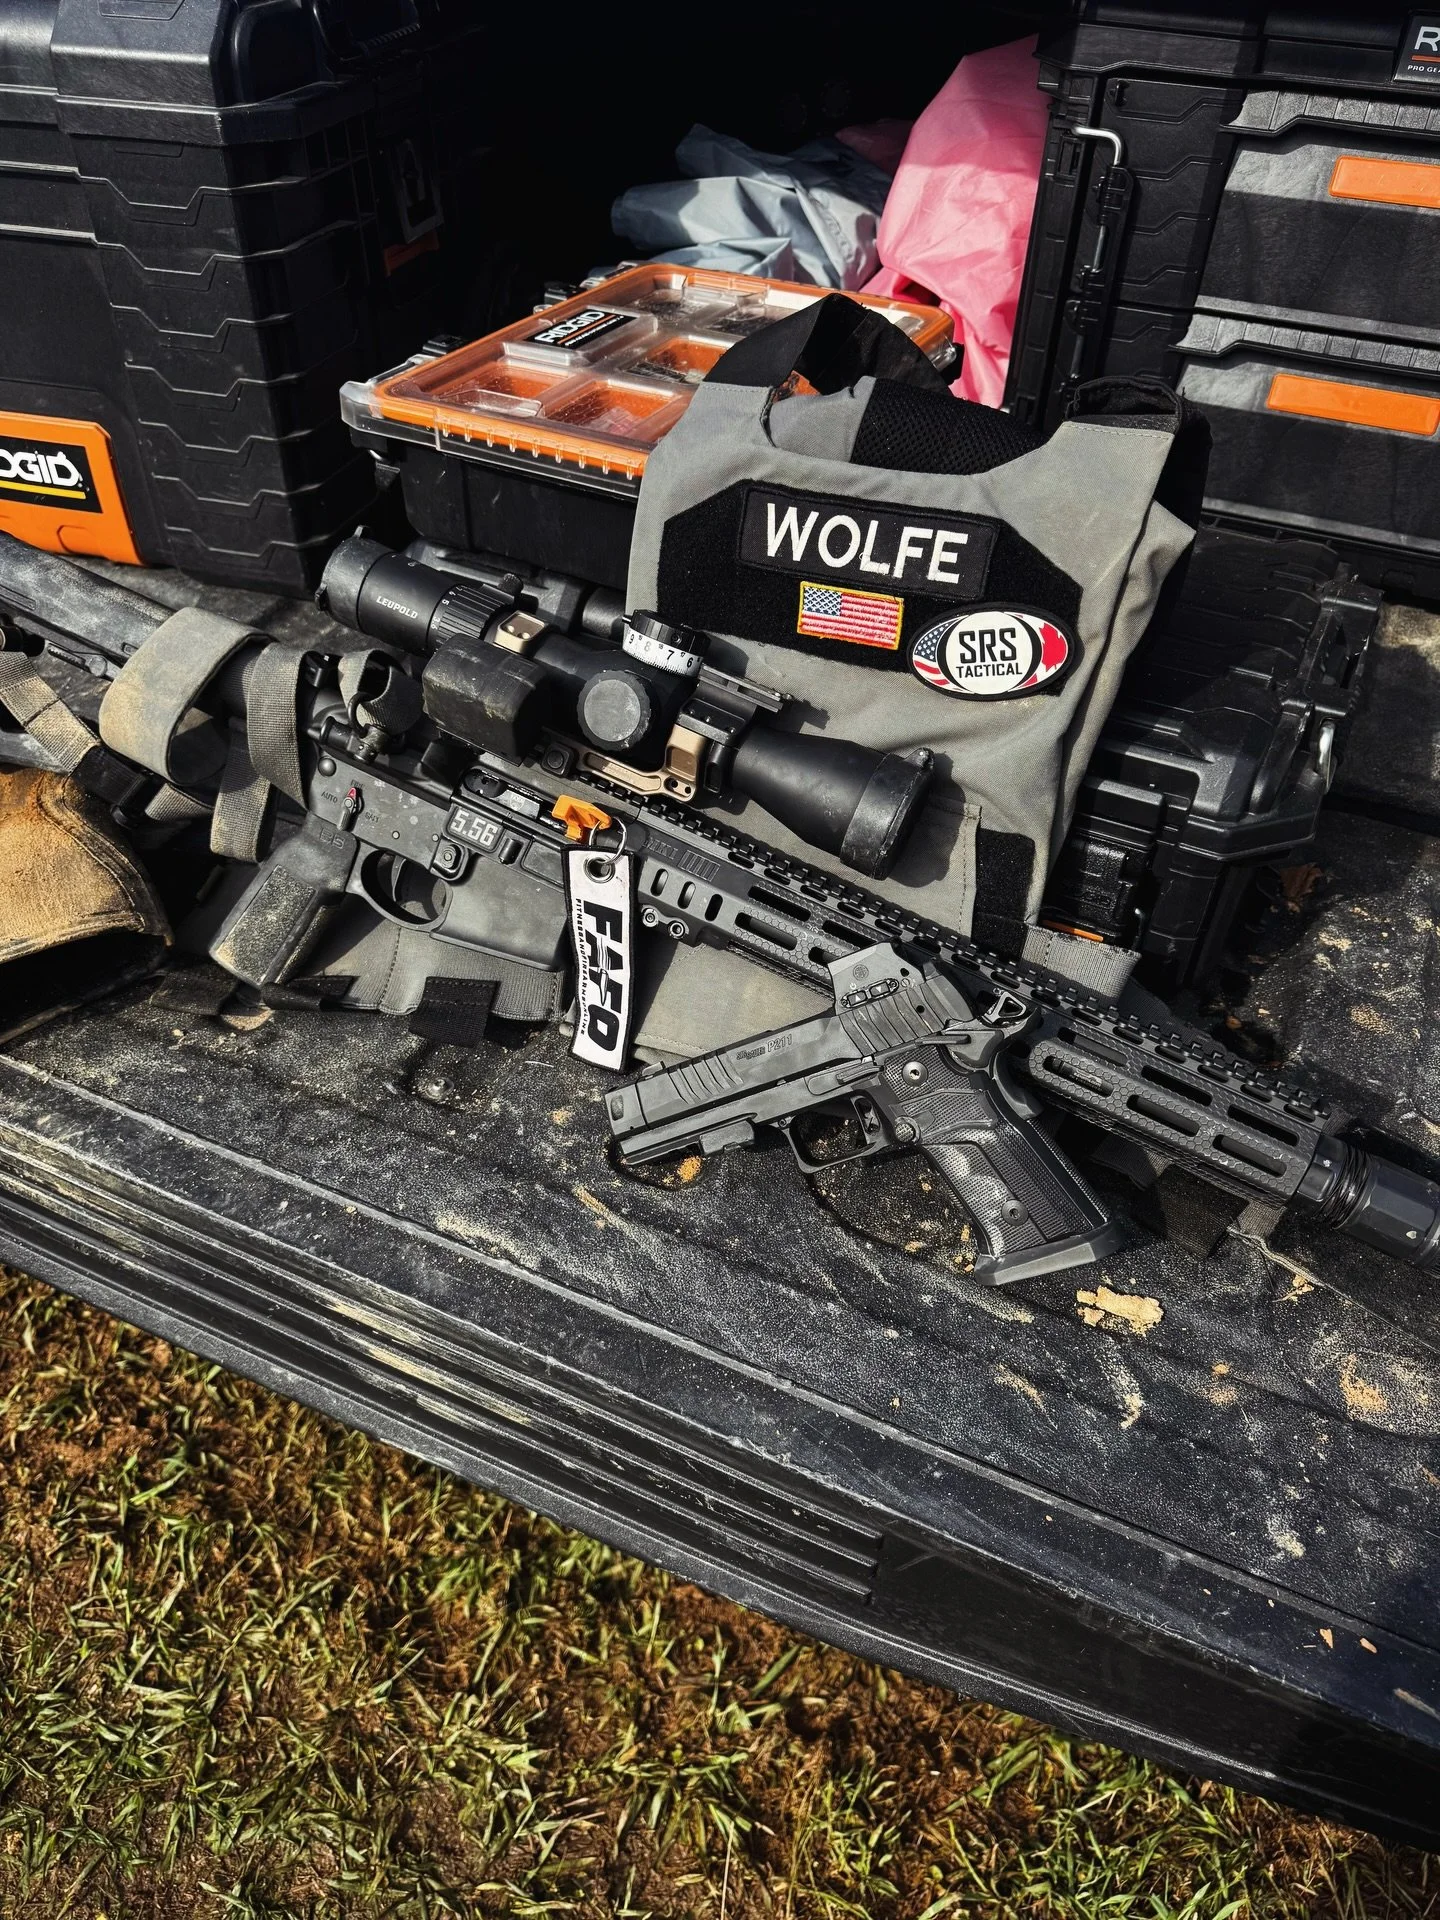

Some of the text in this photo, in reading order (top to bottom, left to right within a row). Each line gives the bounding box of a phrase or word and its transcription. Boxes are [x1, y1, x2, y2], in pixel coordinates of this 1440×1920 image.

[1407, 64, 1425, 72] PRO
[534, 311, 605, 343] RIDGID
[766, 503, 969, 584] WOLFE
[376, 595, 419, 619] LEUPOLD
[958, 627, 1017, 664] SRS
[667, 649, 675, 660] 7
[686, 657, 694, 668] 6
[956, 662, 1023, 678] TACTICAL
[321, 791, 338, 804] AUTO
[450, 809, 498, 846] 5.56
[583, 900, 624, 1052] FAFO
[767, 1033, 793, 1053] P211
